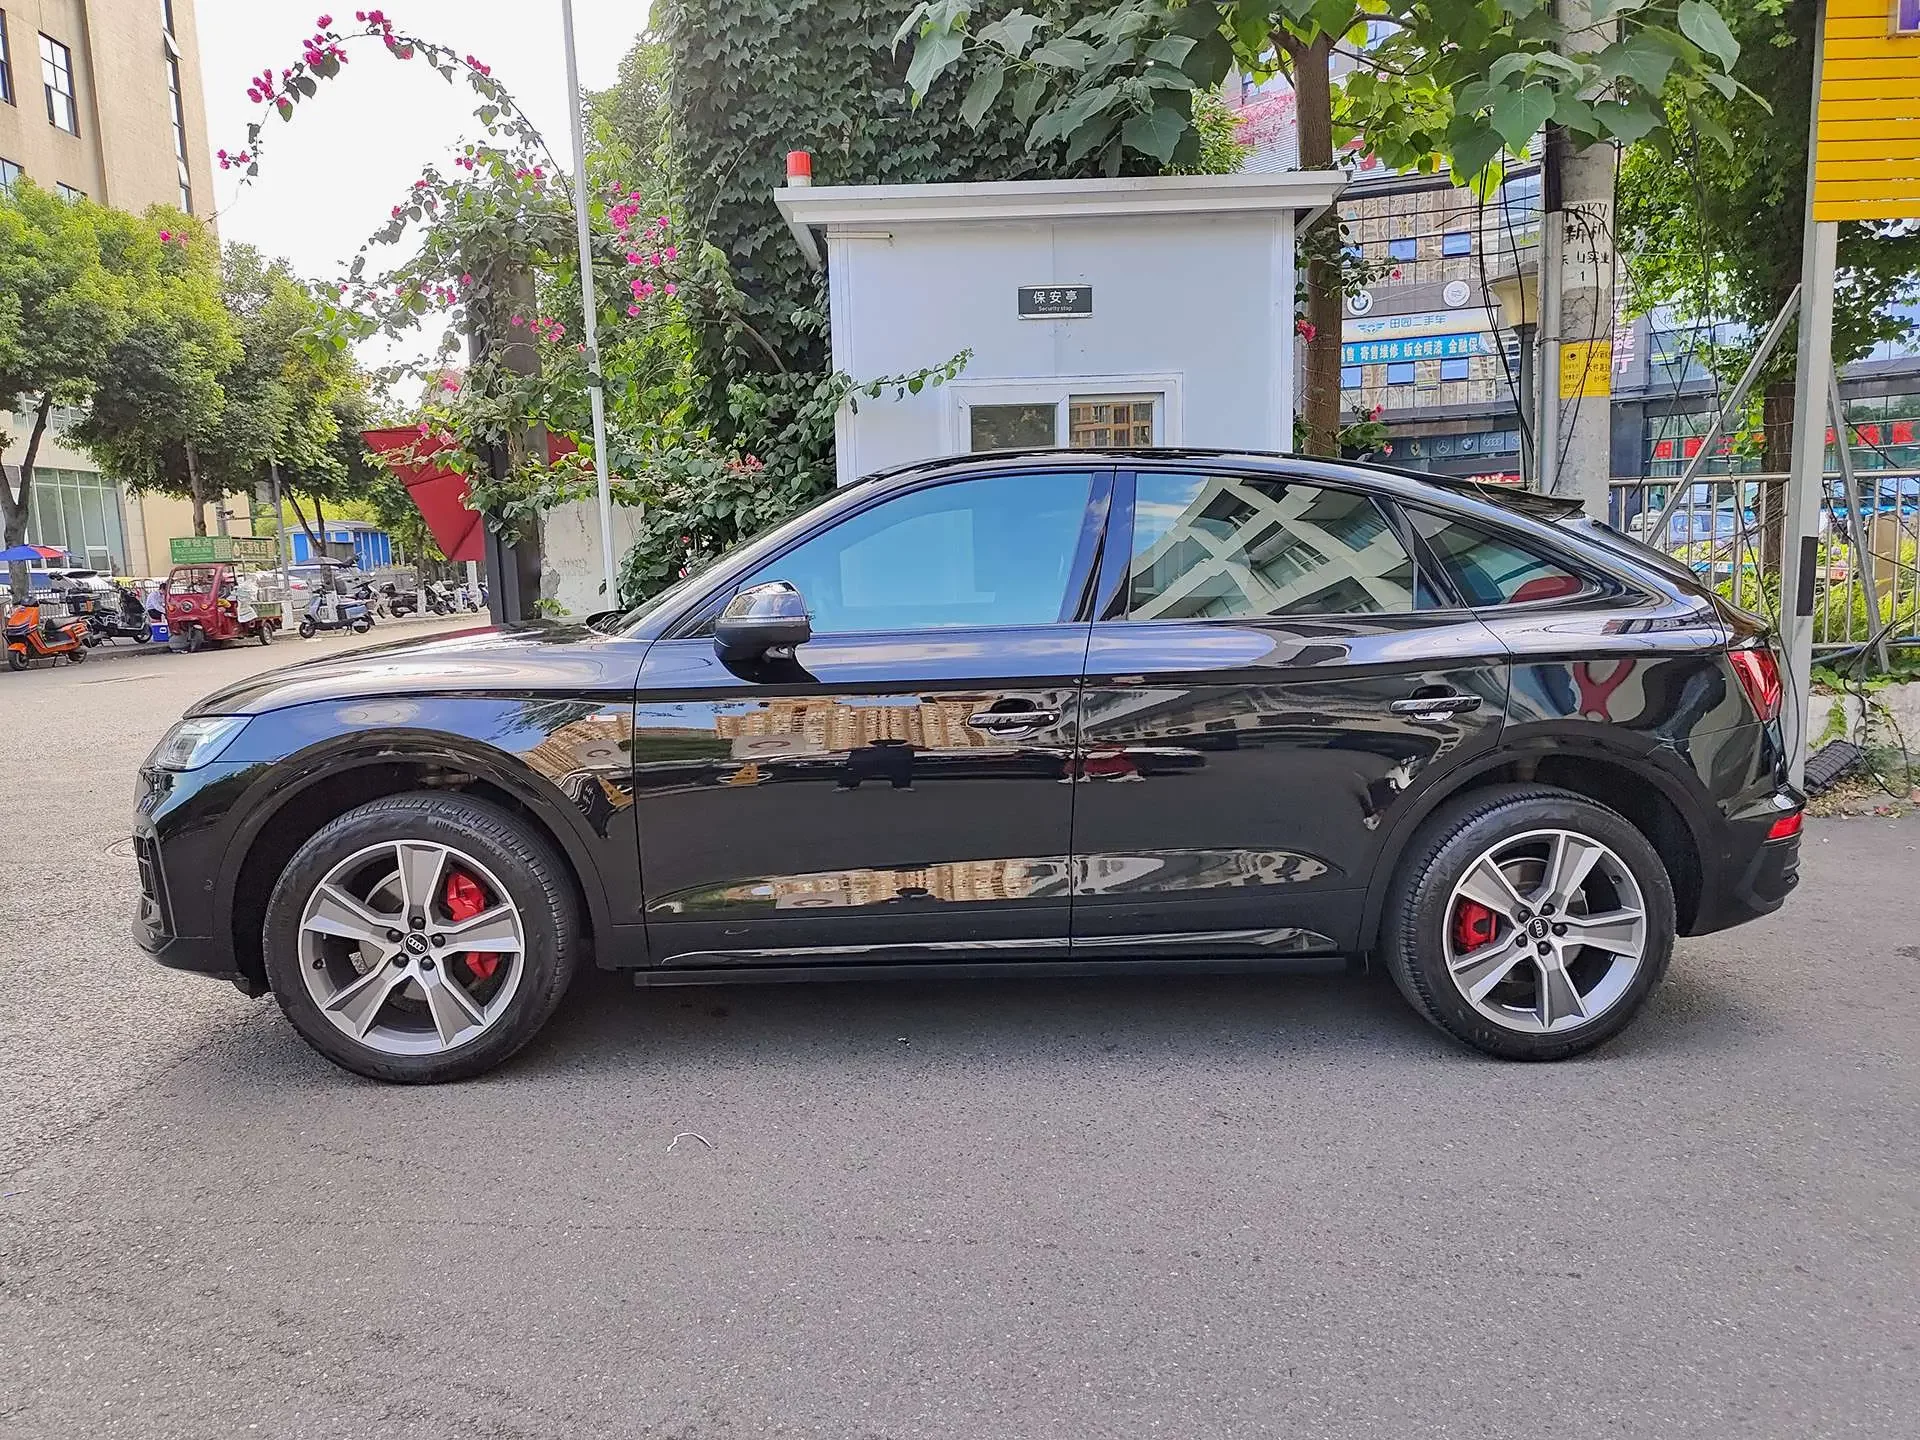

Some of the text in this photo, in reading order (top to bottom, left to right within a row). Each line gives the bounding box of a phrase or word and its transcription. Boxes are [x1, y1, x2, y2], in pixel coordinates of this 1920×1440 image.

[1033, 290, 1077, 304] 保安亭
[1390, 314, 1447, 328] 田园二手车
